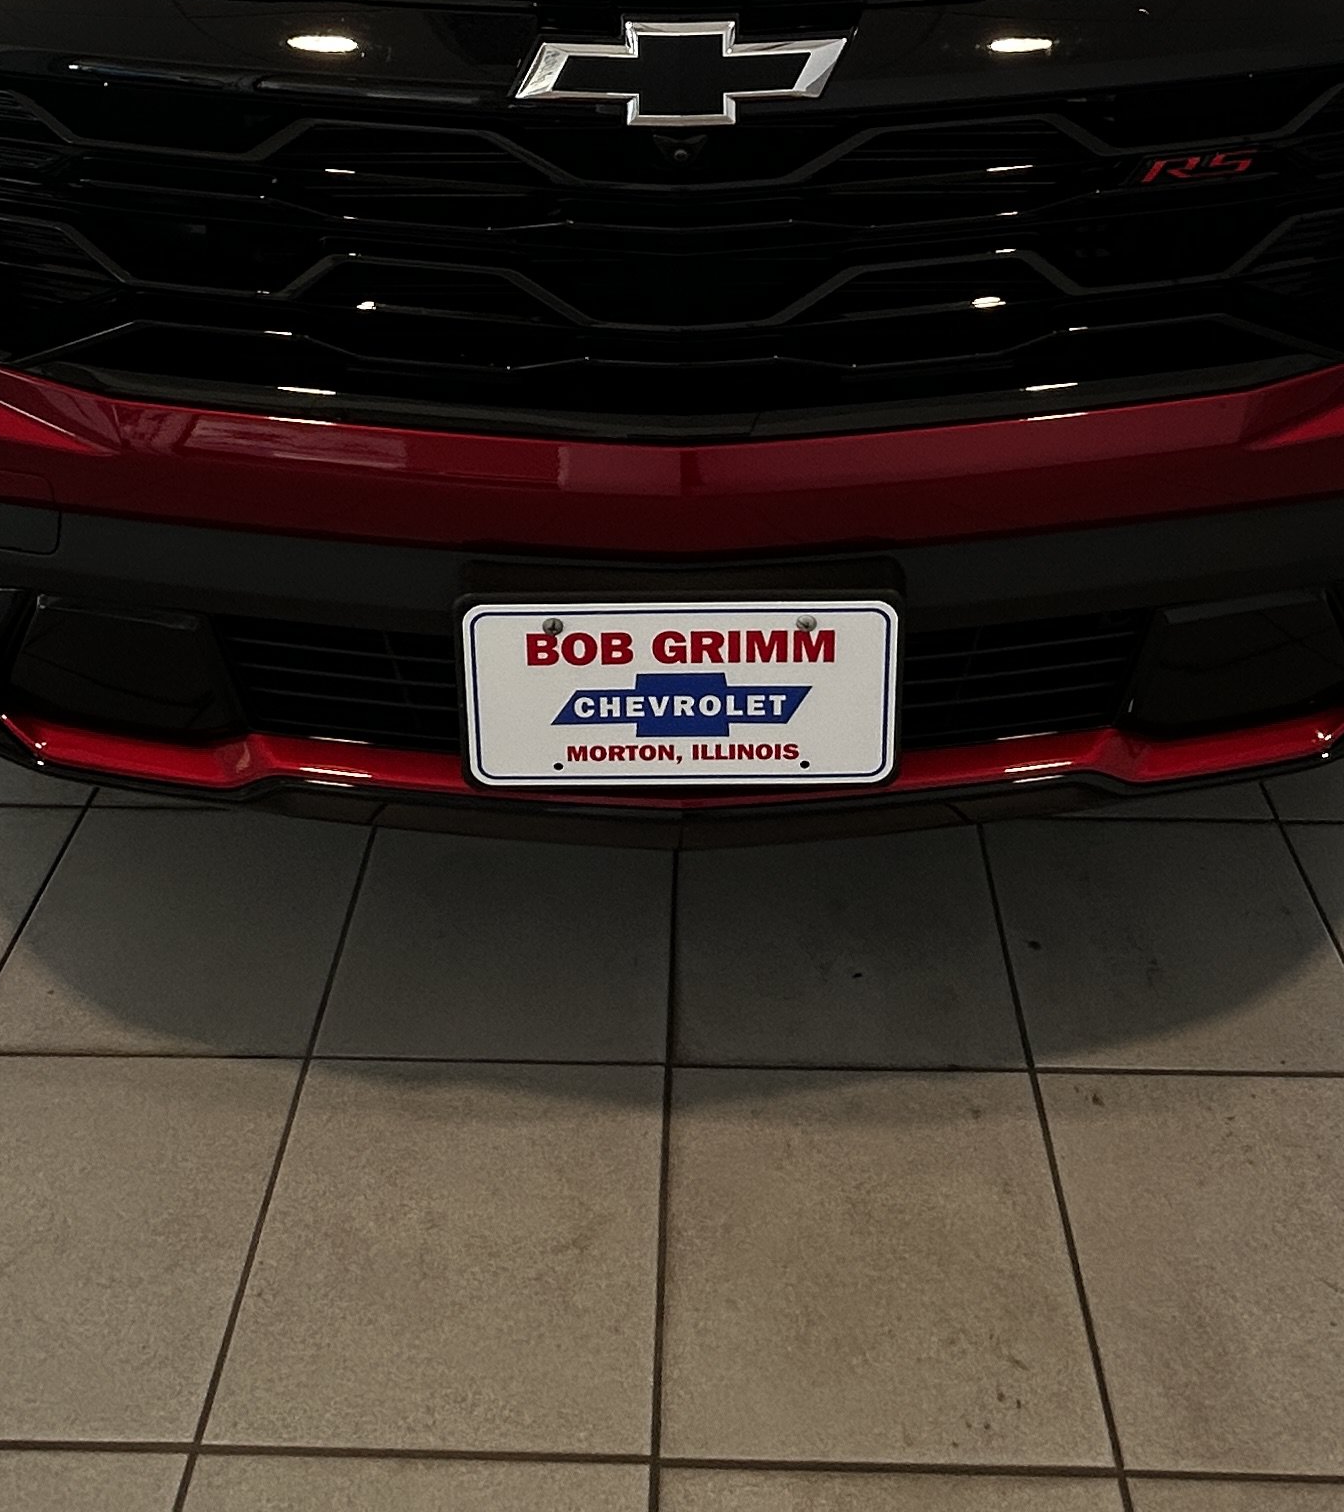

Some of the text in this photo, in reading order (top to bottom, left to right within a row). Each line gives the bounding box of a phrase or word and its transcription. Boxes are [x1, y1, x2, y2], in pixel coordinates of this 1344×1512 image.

[1141, 149, 1258, 183] RS
[526, 630, 836, 666] BOB GRIMM
[573, 694, 787, 719] CHEVROLET
[567, 743, 800, 764] MORTON, ILLINOIS
